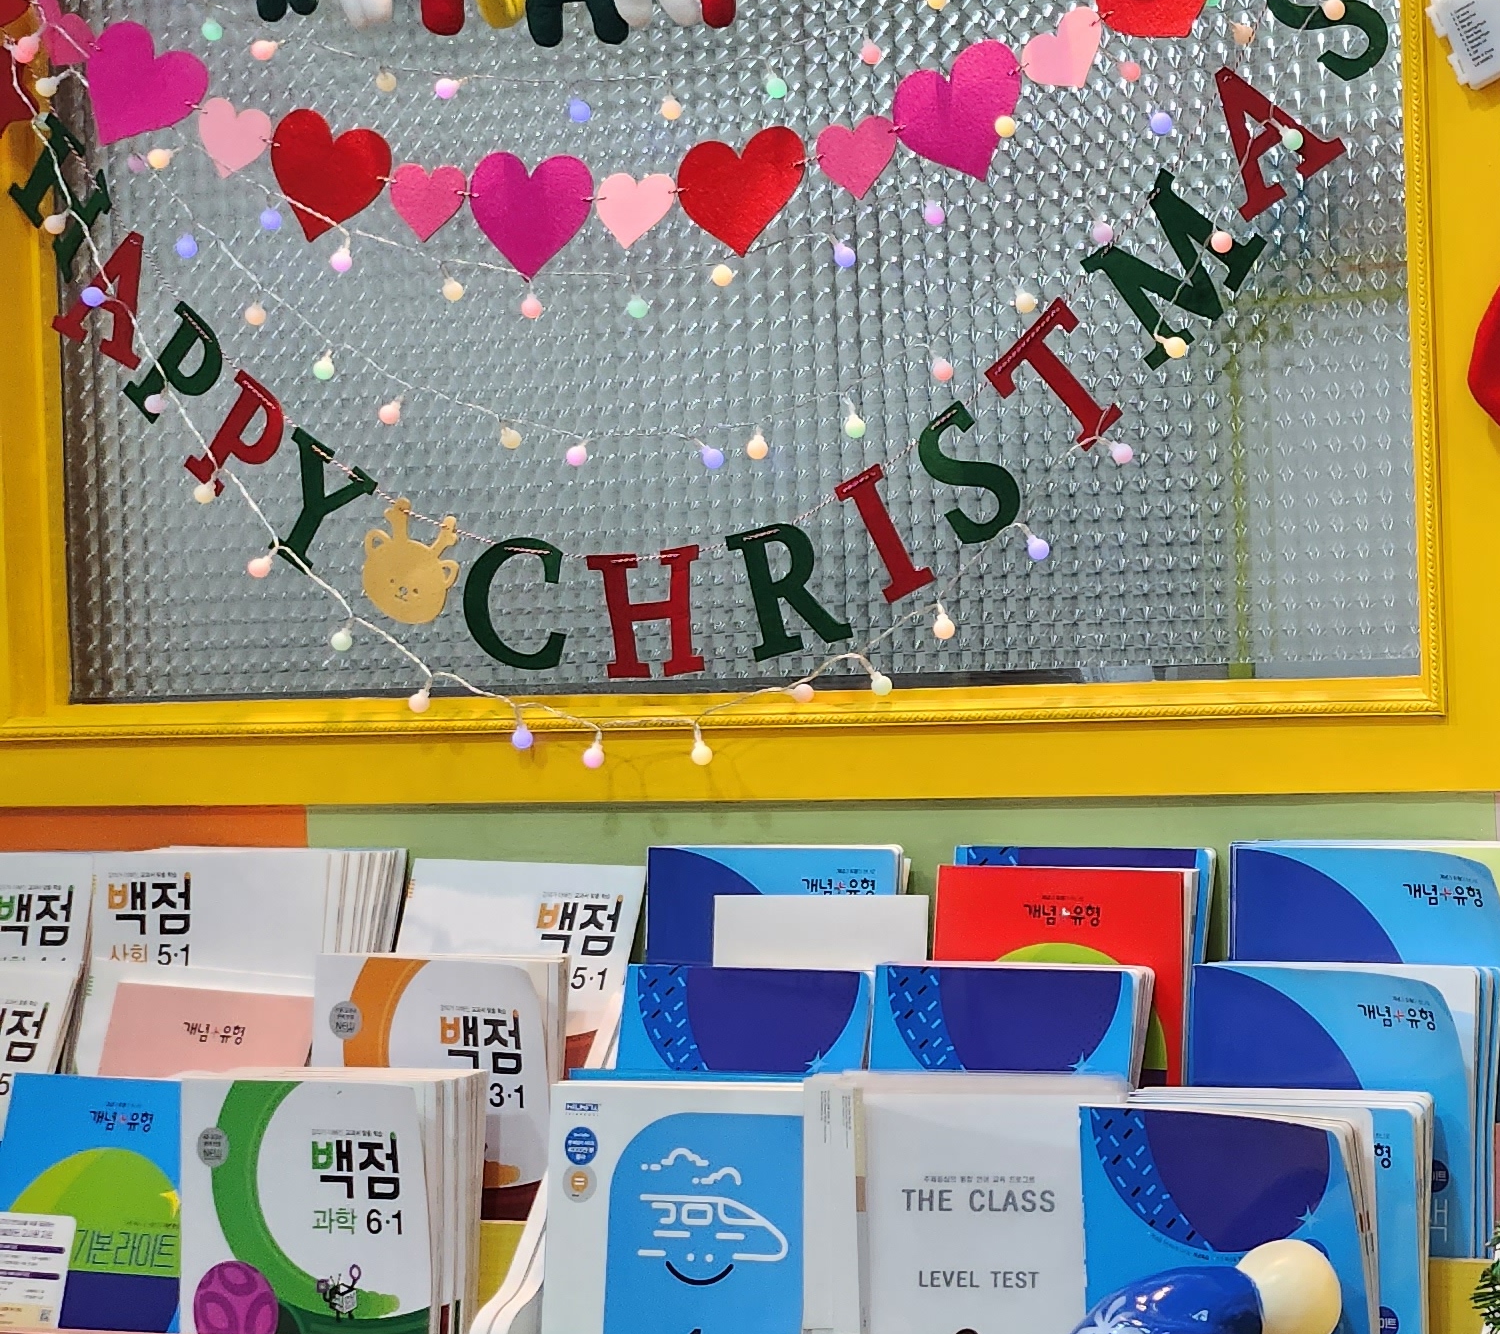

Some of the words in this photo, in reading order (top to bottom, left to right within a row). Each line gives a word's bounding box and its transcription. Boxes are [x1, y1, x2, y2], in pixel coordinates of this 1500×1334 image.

[8, 113, 378, 575] HAPPY
[108, 871, 191, 935] 백점
[1403, 882, 1484, 908] 개념+유형
[0, 885, 75, 947] 백점
[536, 894, 624, 956] 백점
[109, 944, 147, 962] 사회
[157, 944, 190, 966] 5·1
[571, 967, 608, 990] 5·1
[1357, 1004, 1436, 1031] 개념+유형
[0, 1002, 50, 1063] 점
[183, 1021, 247, 1046] 개념+유형
[439, 1009, 523, 1075] 백점
[489, 1082, 525, 1109] 3·1
[90, 1109, 154, 1133] 개념+유형
[311, 1131, 400, 1200] 백점
[901, 1189, 953, 1212] THE
[969, 1189, 1055, 1212] CLASS
[312, 1207, 358, 1236] 과학
[366, 1208, 404, 1236] 6·1
[918, 1270, 980, 1288] LEVEL
[990, 1271, 1040, 1288] TEST
